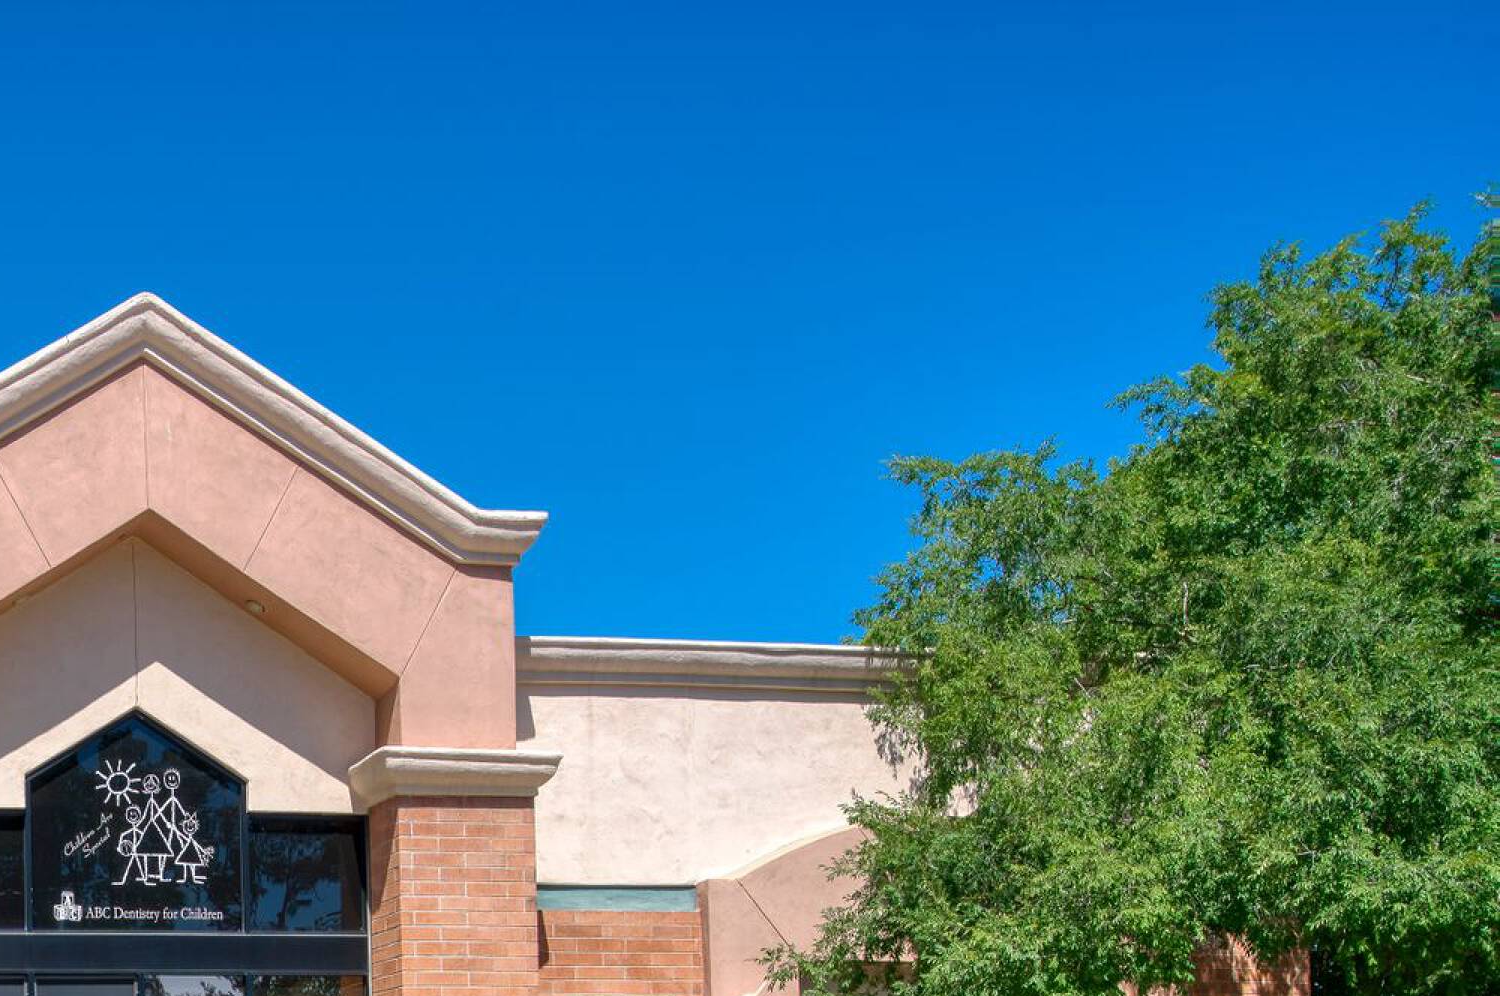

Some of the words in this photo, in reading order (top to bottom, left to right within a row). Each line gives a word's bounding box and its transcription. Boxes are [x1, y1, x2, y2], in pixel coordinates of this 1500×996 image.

[85, 907, 111, 921] ABC
[113, 907, 160, 923] Dentistry
[162, 907, 178, 921] for
[180, 906, 224, 921] Children
